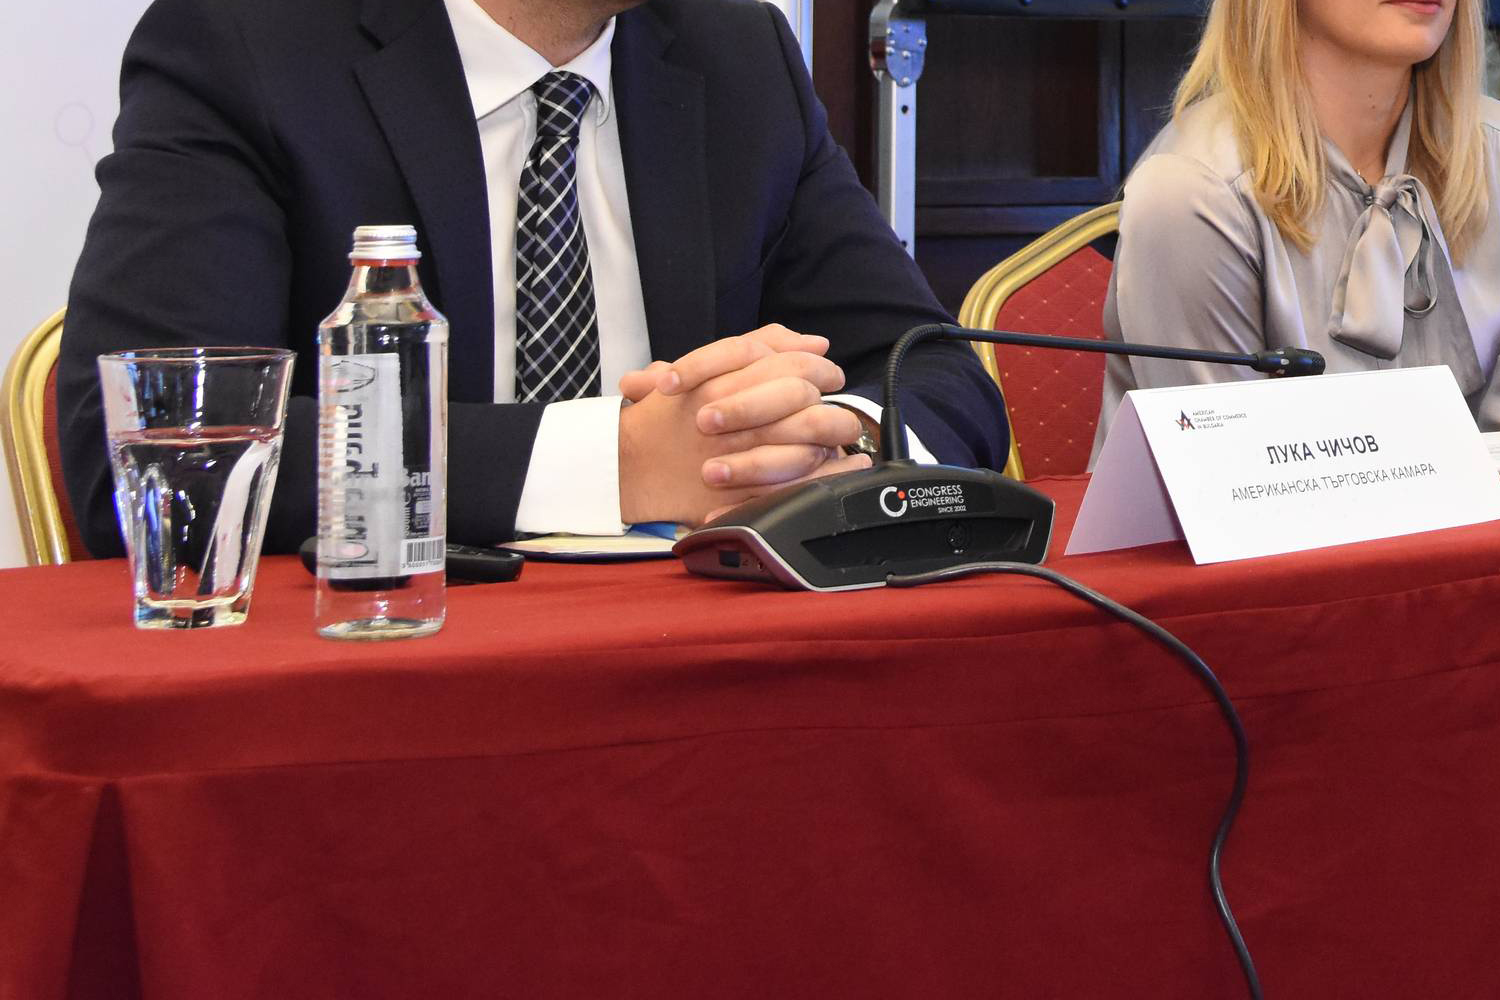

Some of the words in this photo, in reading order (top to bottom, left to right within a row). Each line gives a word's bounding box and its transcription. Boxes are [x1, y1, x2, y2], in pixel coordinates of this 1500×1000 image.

[1266, 441, 1316, 465] ЛУКА
[1316, 434, 1380, 458] ЧИЧОВ
[908, 485, 963, 498] CONGRESS
[1231, 477, 1321, 502] АМЕРИКАНСКА
[1320, 468, 1391, 490] ТЪРГОВСКА
[1389, 462, 1438, 480] КАМАРА
[910, 495, 964, 508] ENGINEERING
